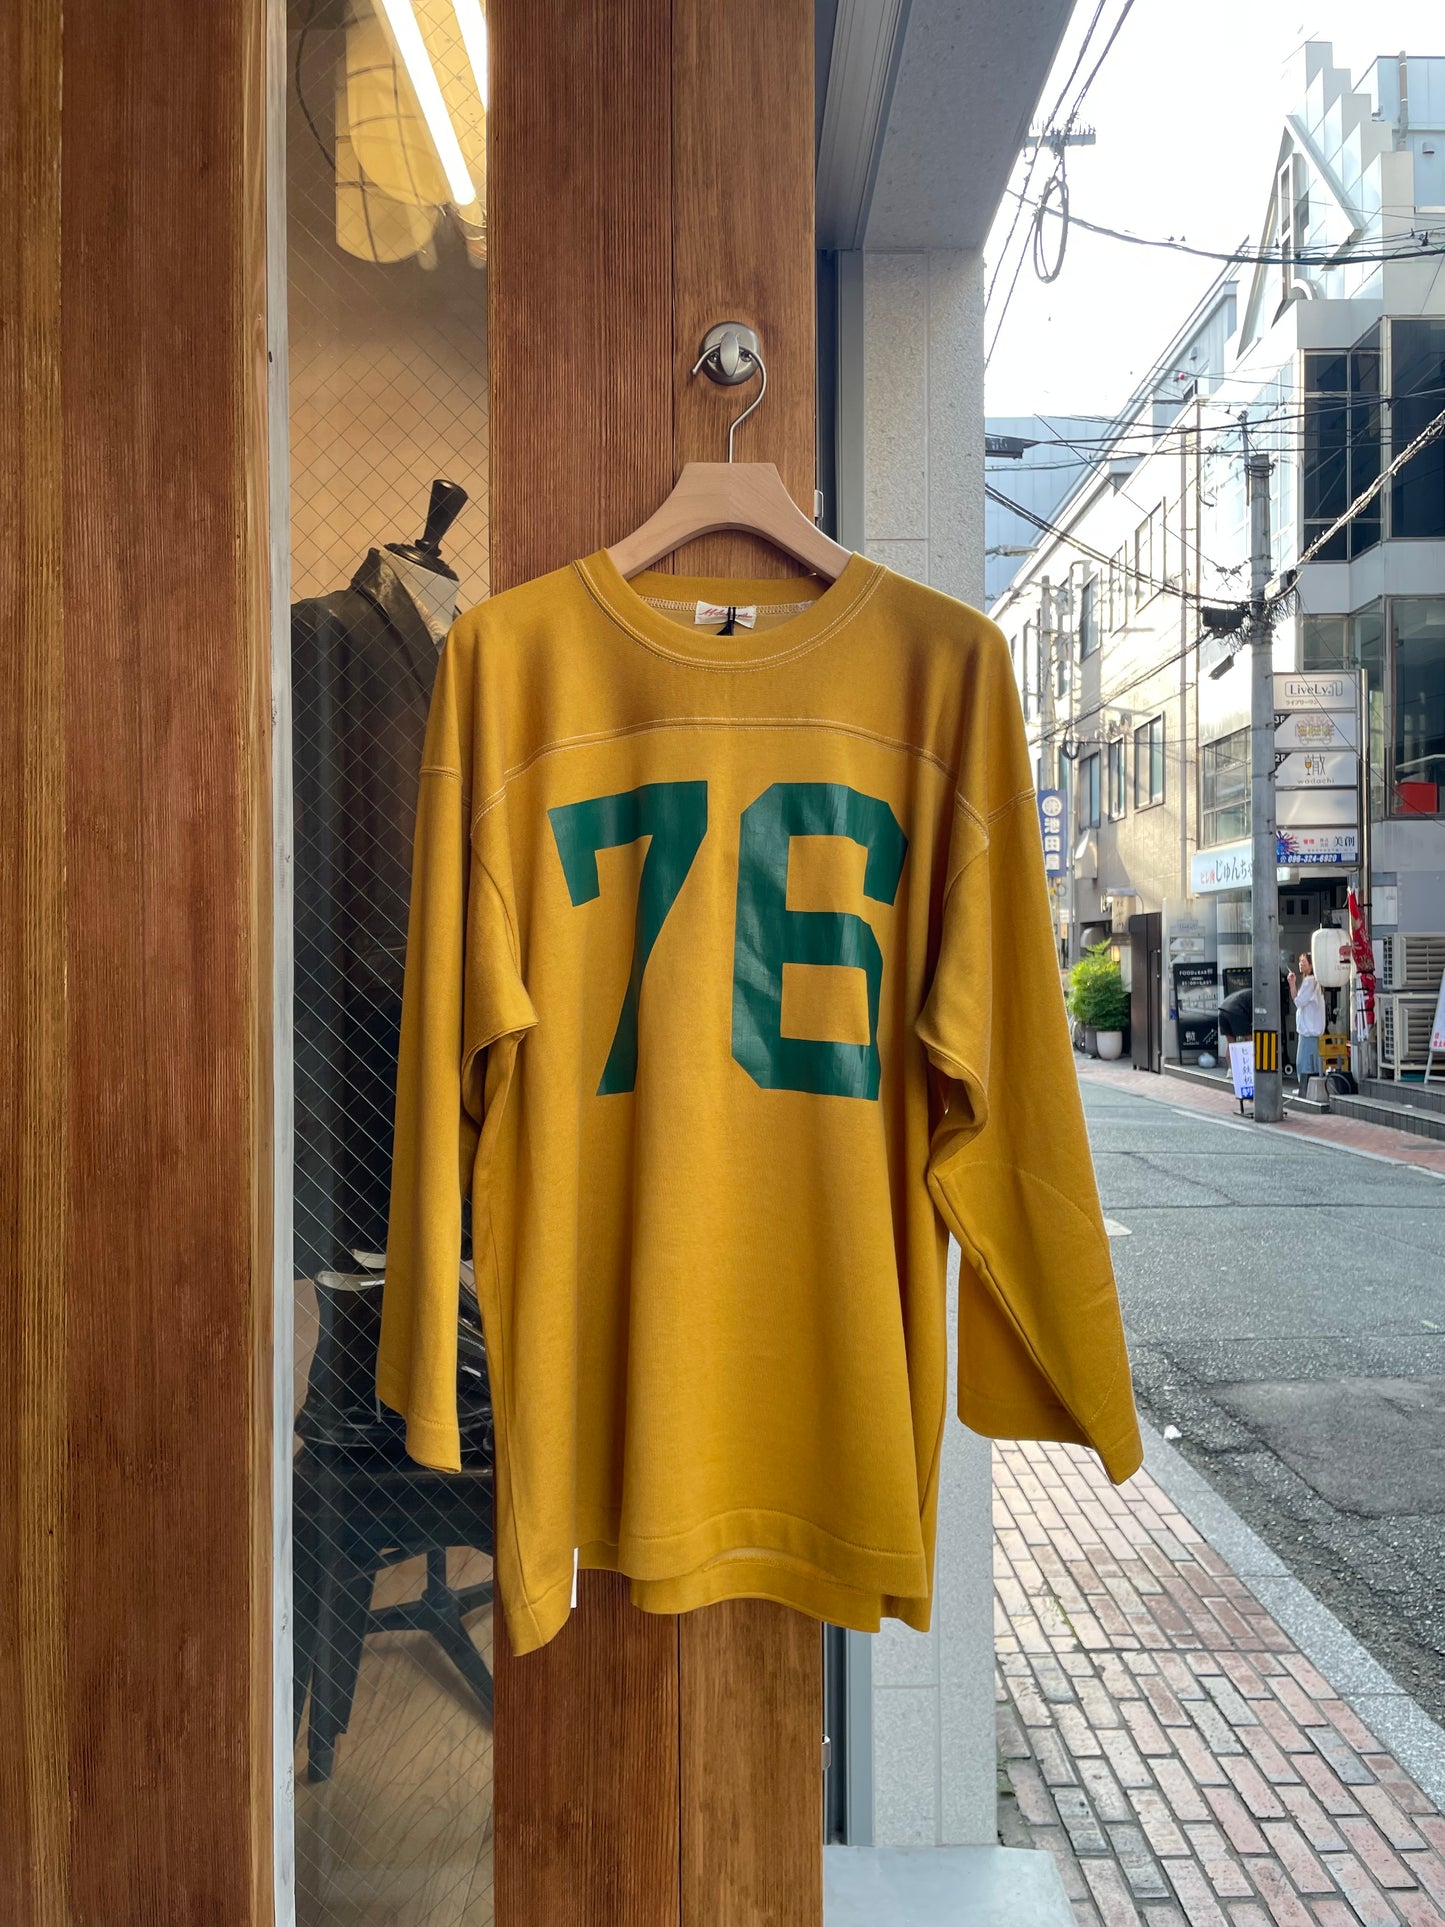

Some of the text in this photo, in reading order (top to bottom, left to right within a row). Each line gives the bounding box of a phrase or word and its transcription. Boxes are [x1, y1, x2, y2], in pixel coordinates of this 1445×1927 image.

[1274, 715, 1285, 724] 3F
[1275, 754, 1286, 763] 2F
[547, 780, 908, 1101] 76
